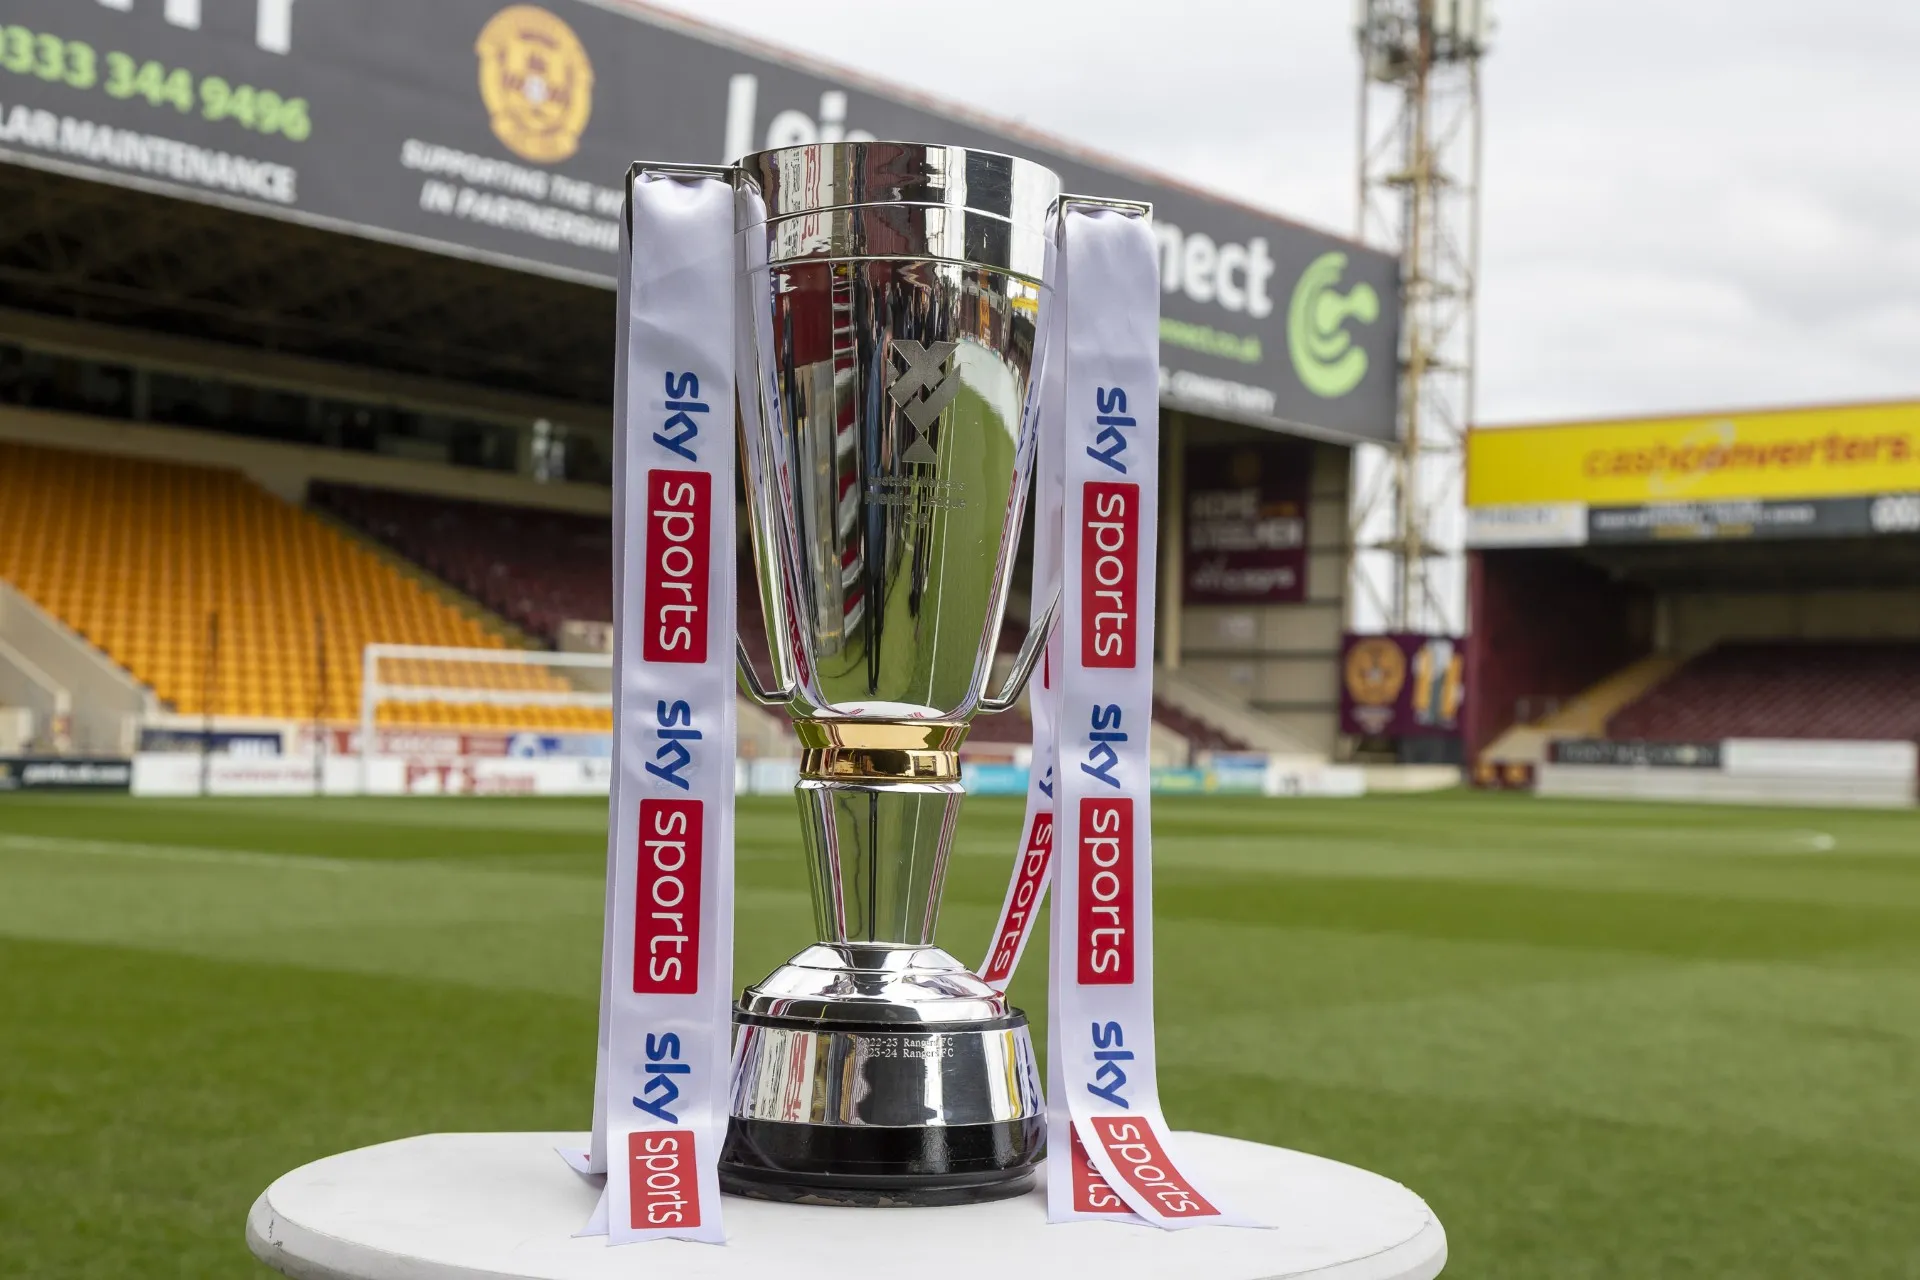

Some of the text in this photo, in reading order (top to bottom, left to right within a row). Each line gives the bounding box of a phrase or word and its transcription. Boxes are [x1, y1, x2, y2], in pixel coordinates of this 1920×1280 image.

[0, 25, 97, 89] 333
[104, 51, 194, 114] 344
[200, 76, 311, 141] 9496
[59, 116, 298, 204] MAINTENANCE
[653, 371, 710, 652] sky sports
[1086, 387, 1137, 657] sky sports
[644, 700, 703, 982] sky sports
[994, 823, 1053, 972] sports
[1080, 703, 1128, 974] sky sports
[632, 1032, 691, 1224] sky sports
[858, 1048, 897, 1058] 023-24
[1086, 1020, 1201, 1213] sky sports
